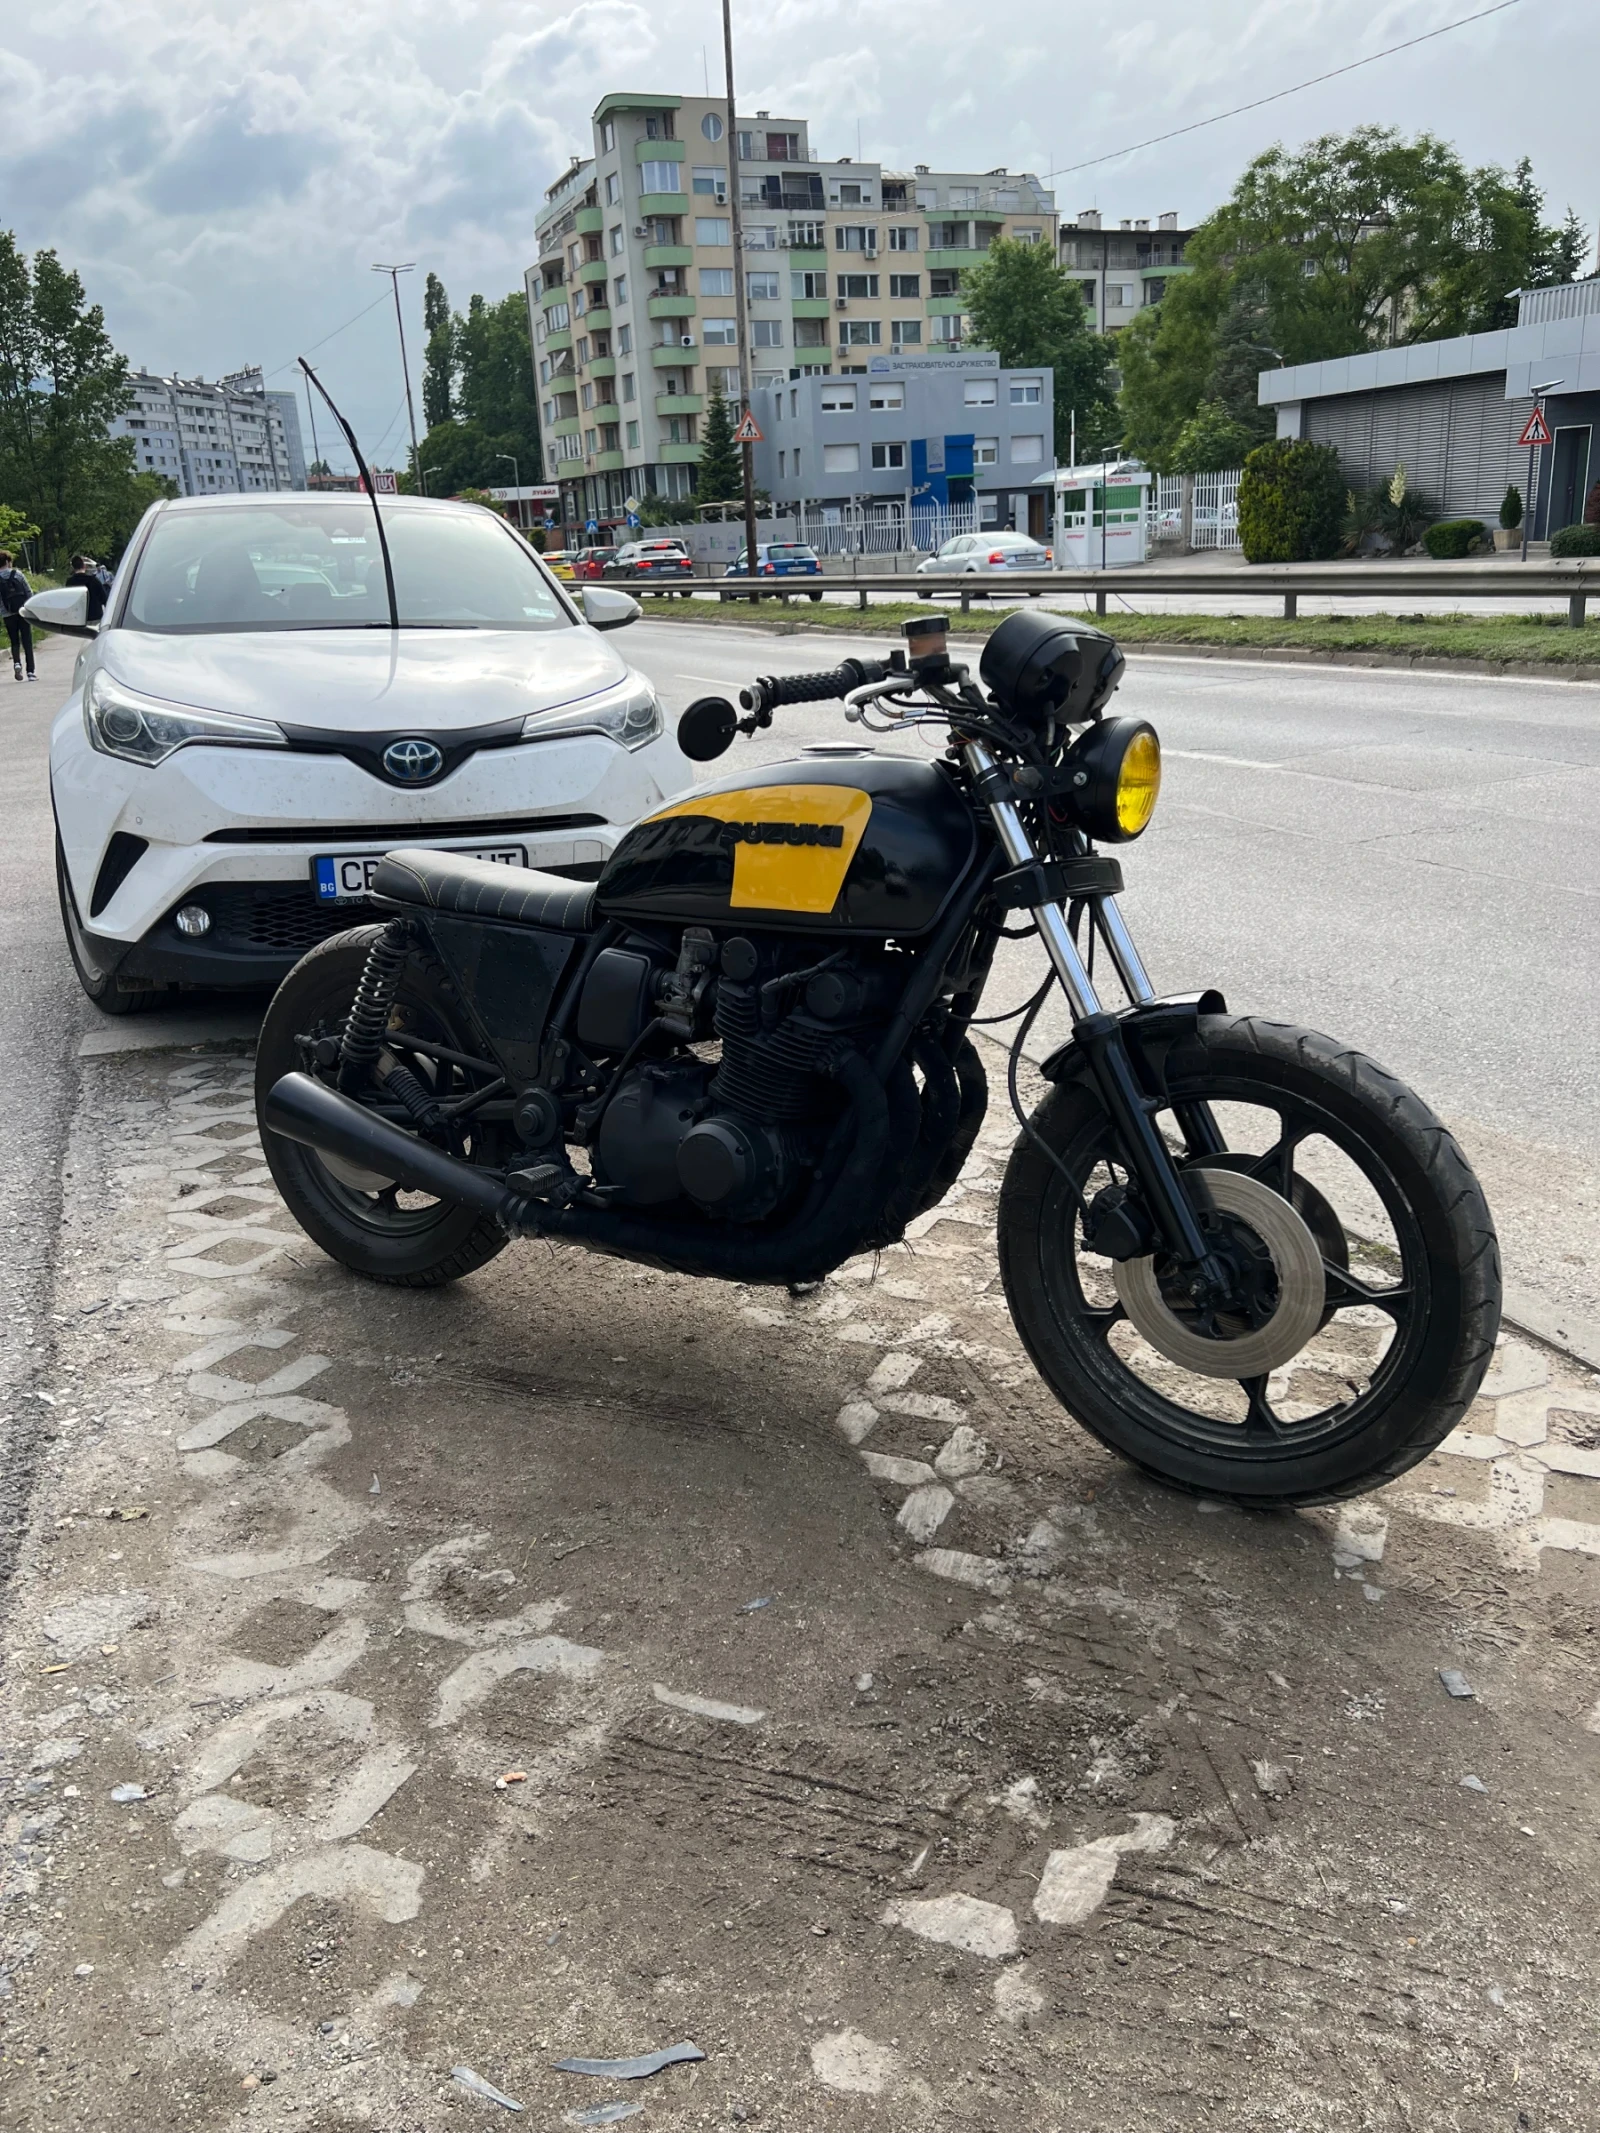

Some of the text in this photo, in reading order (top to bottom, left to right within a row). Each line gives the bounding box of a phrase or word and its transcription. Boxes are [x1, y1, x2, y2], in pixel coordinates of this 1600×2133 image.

[892, 360, 997, 370] ЗАСТРАХОВАТЕЛНО ДРУЖЕСТВО
[719, 821, 844, 848] SUZUKI
[320, 882, 335, 893] BG
